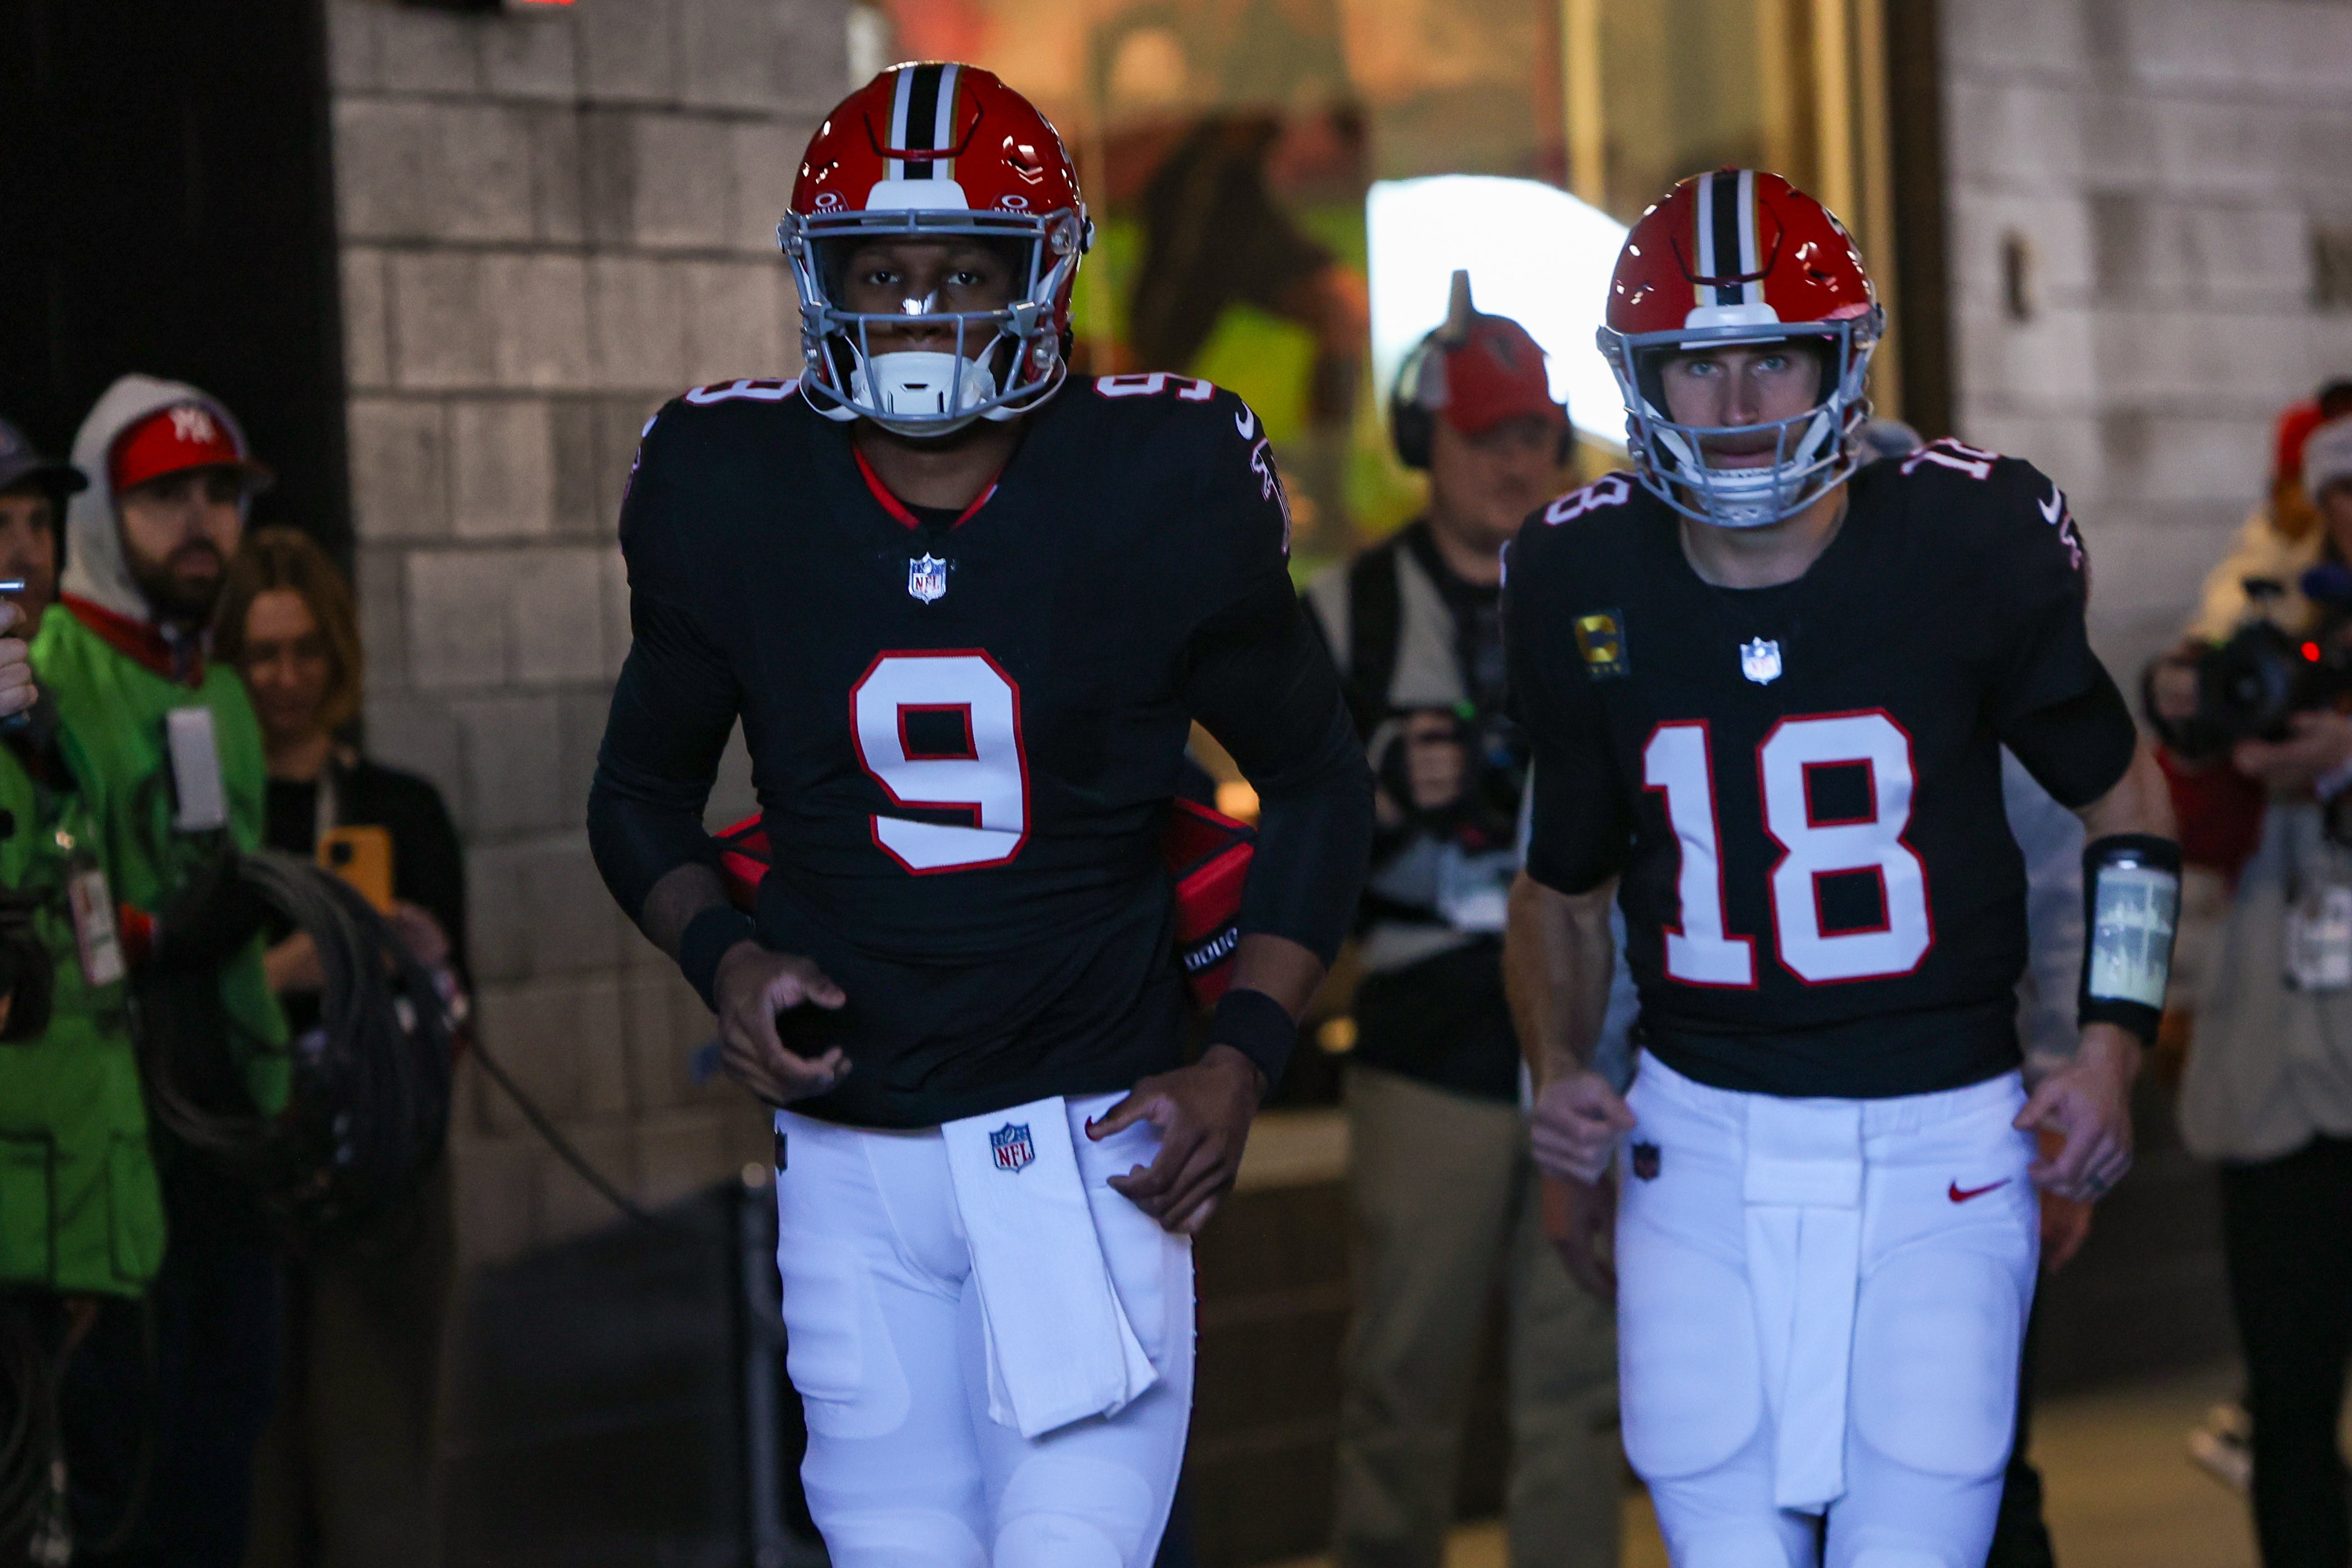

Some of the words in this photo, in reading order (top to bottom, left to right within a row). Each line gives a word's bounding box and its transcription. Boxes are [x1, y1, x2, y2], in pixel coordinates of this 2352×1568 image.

[1575, 614, 1619, 663] C
[849, 648, 1031, 876] 9
[1641, 706, 1936, 990] 18
[997, 1142, 1032, 1167] NFL
